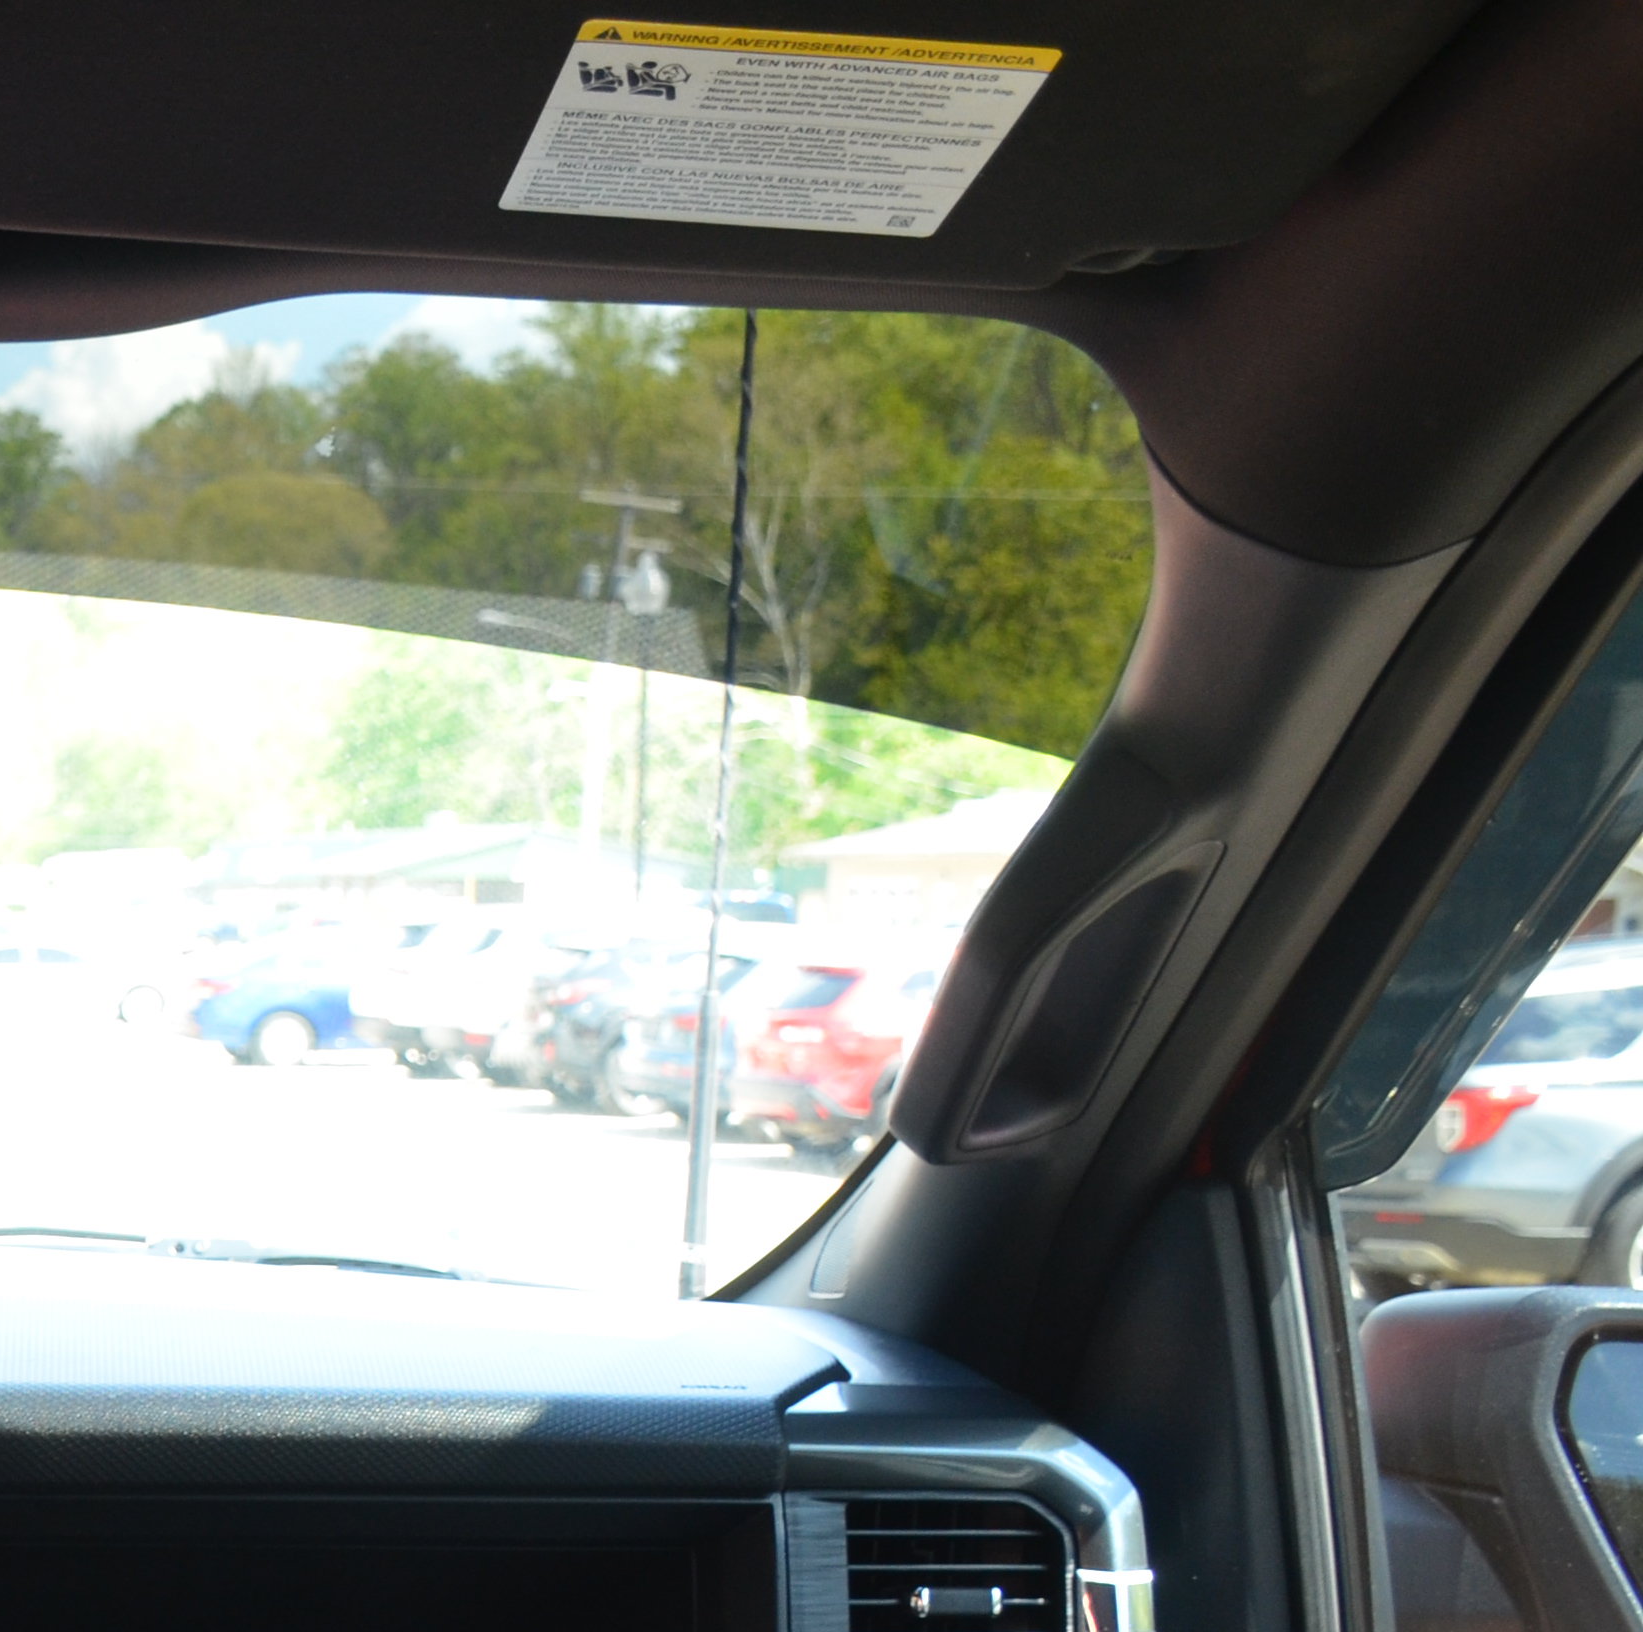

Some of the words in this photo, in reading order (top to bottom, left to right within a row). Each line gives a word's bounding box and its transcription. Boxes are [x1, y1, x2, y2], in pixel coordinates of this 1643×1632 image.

[629, 30, 719, 45] WARNING
[735, 57, 780, 68] EVEN
[782, 60, 826, 71] WITH
[826, 63, 919, 77] ADVANCED
[919, 69, 951, 79] AIR
[951, 71, 1002, 82] BAGS
